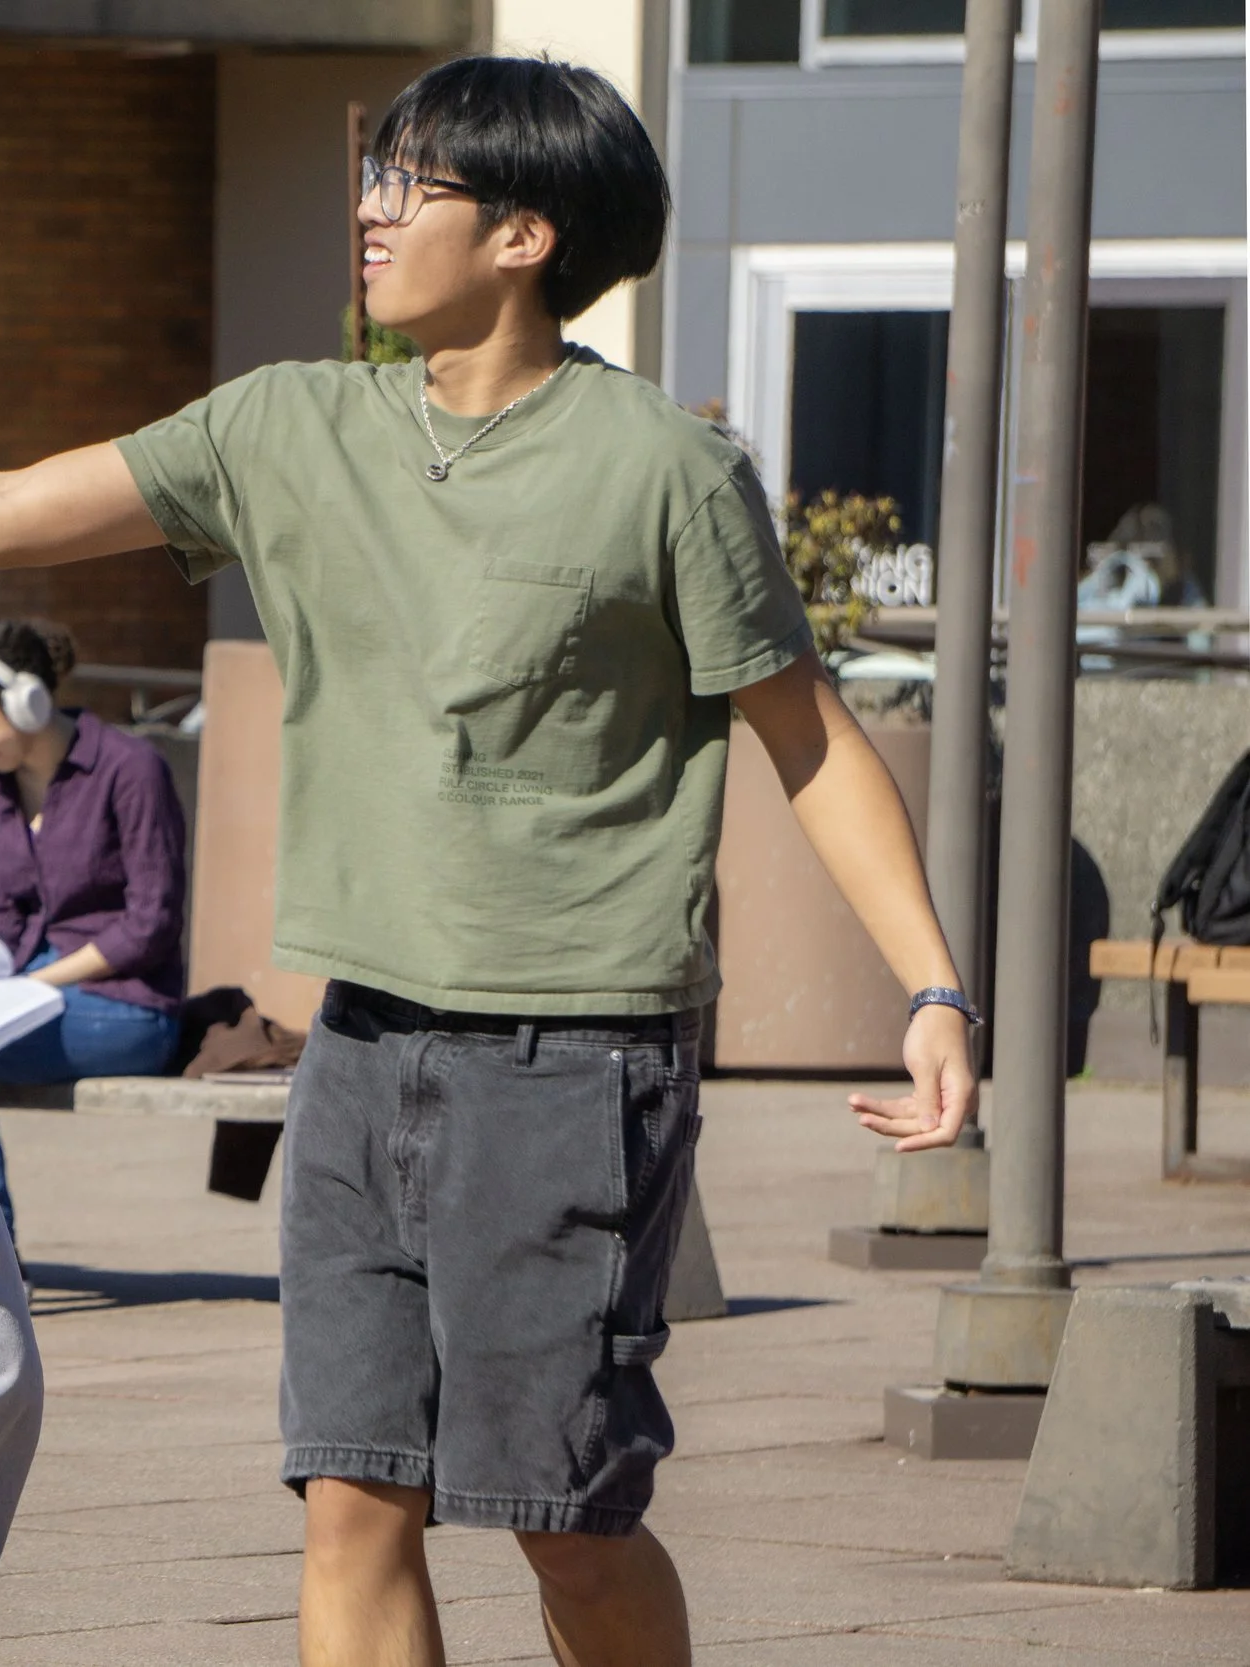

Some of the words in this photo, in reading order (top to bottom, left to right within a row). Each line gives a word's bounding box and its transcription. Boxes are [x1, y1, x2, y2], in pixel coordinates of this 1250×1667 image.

[466, 779, 511, 793] CIRCLE
[512, 783, 553, 796] LIVING
[446, 792, 497, 806] COLOUR
[499, 795, 546, 806] RANGE
